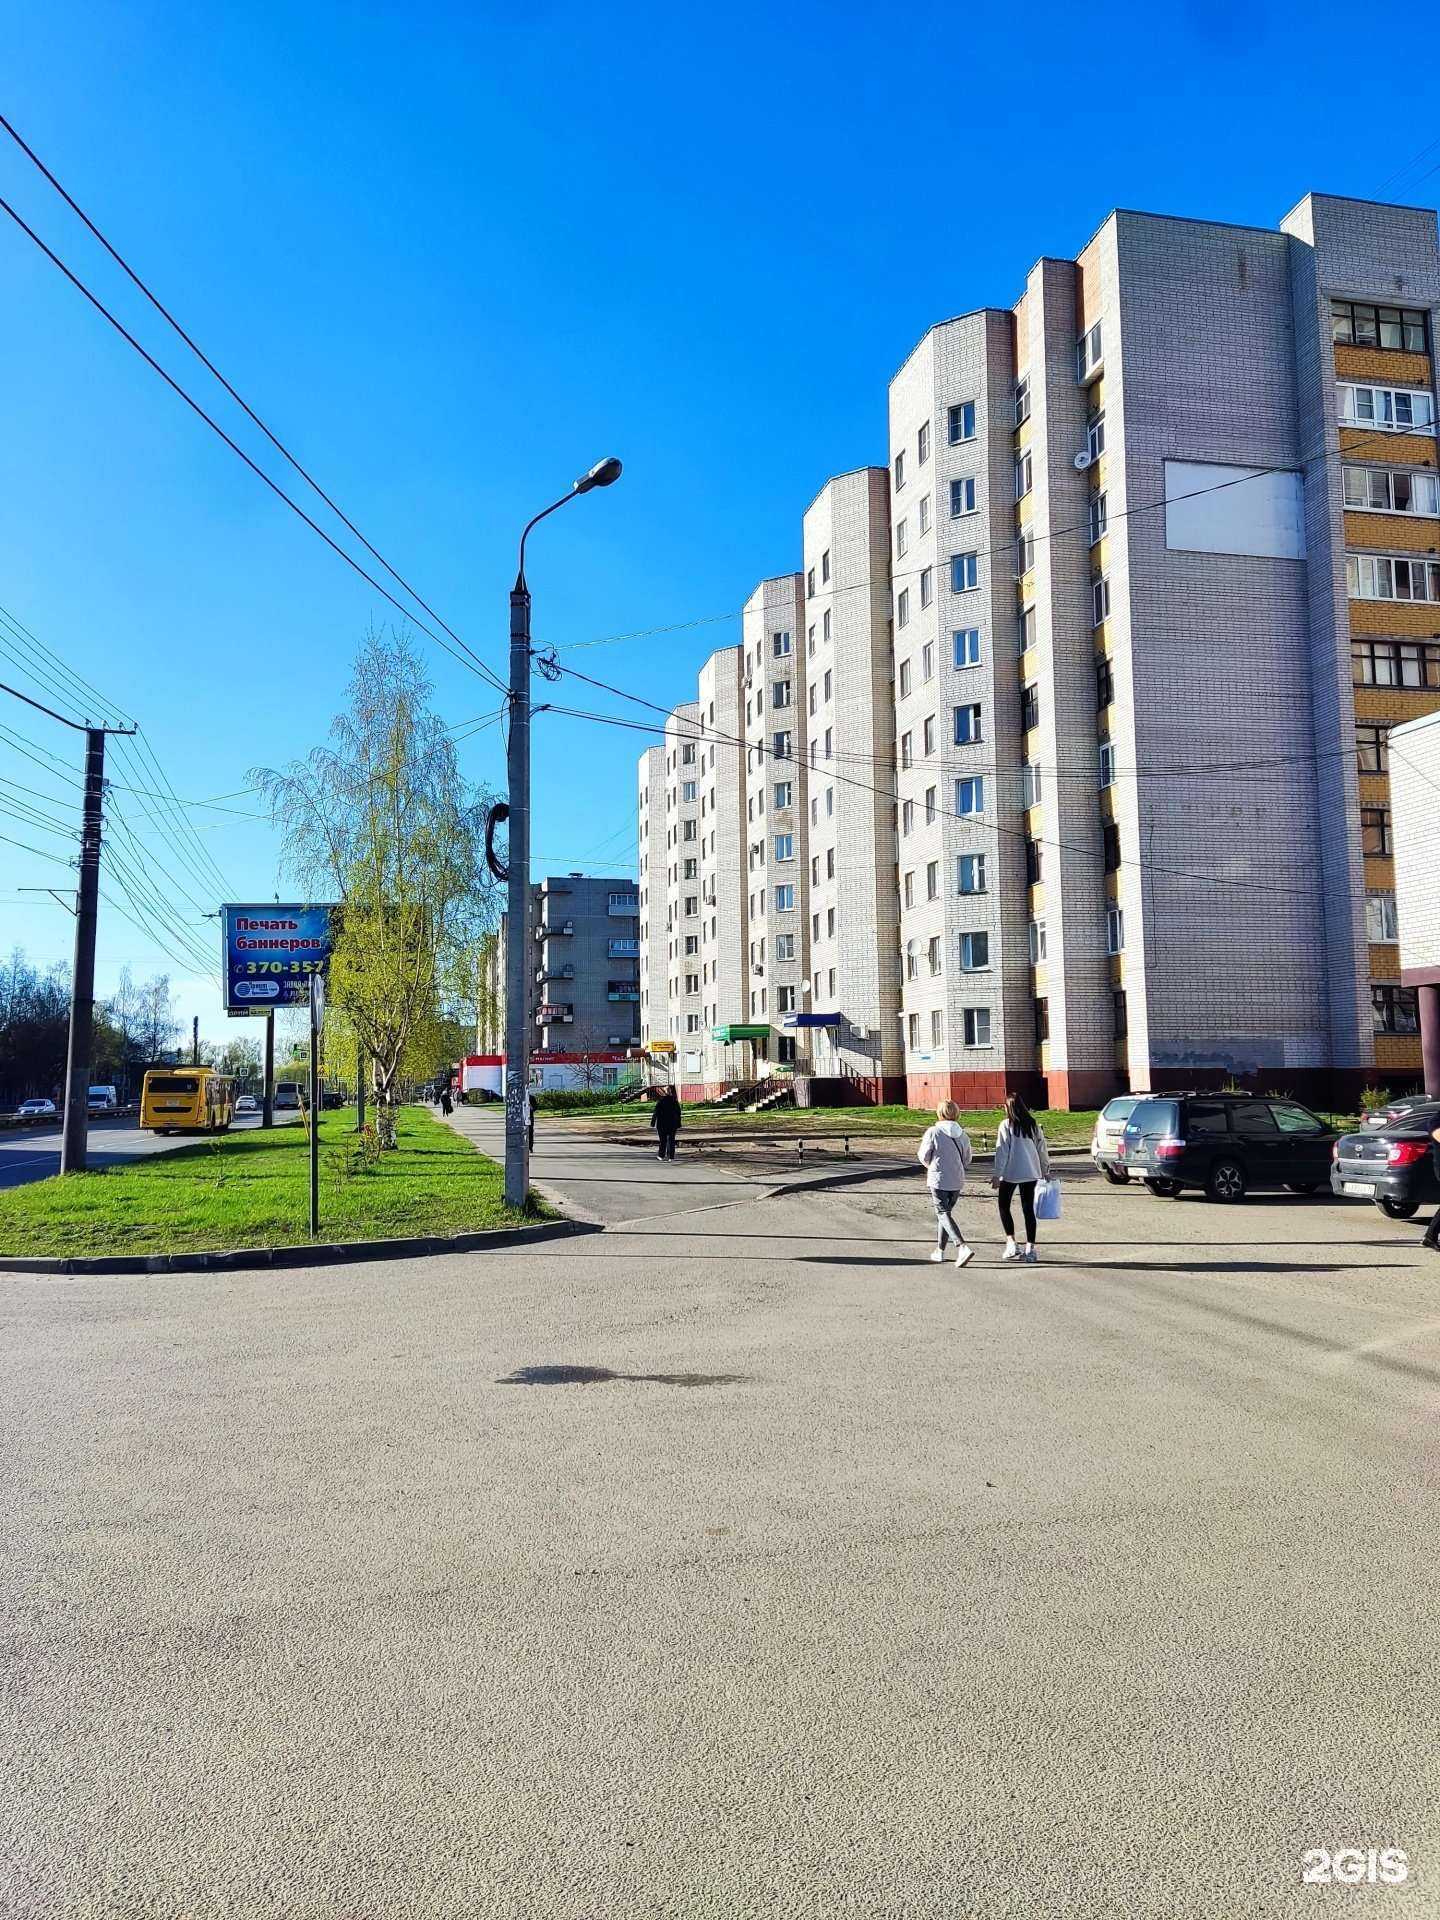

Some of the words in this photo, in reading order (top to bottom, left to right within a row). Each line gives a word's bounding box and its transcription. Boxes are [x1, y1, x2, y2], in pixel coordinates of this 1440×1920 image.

[236, 917, 298, 931] Печать
[236, 936, 321, 953] баннеров
[246, 961, 324, 974] 370-357
